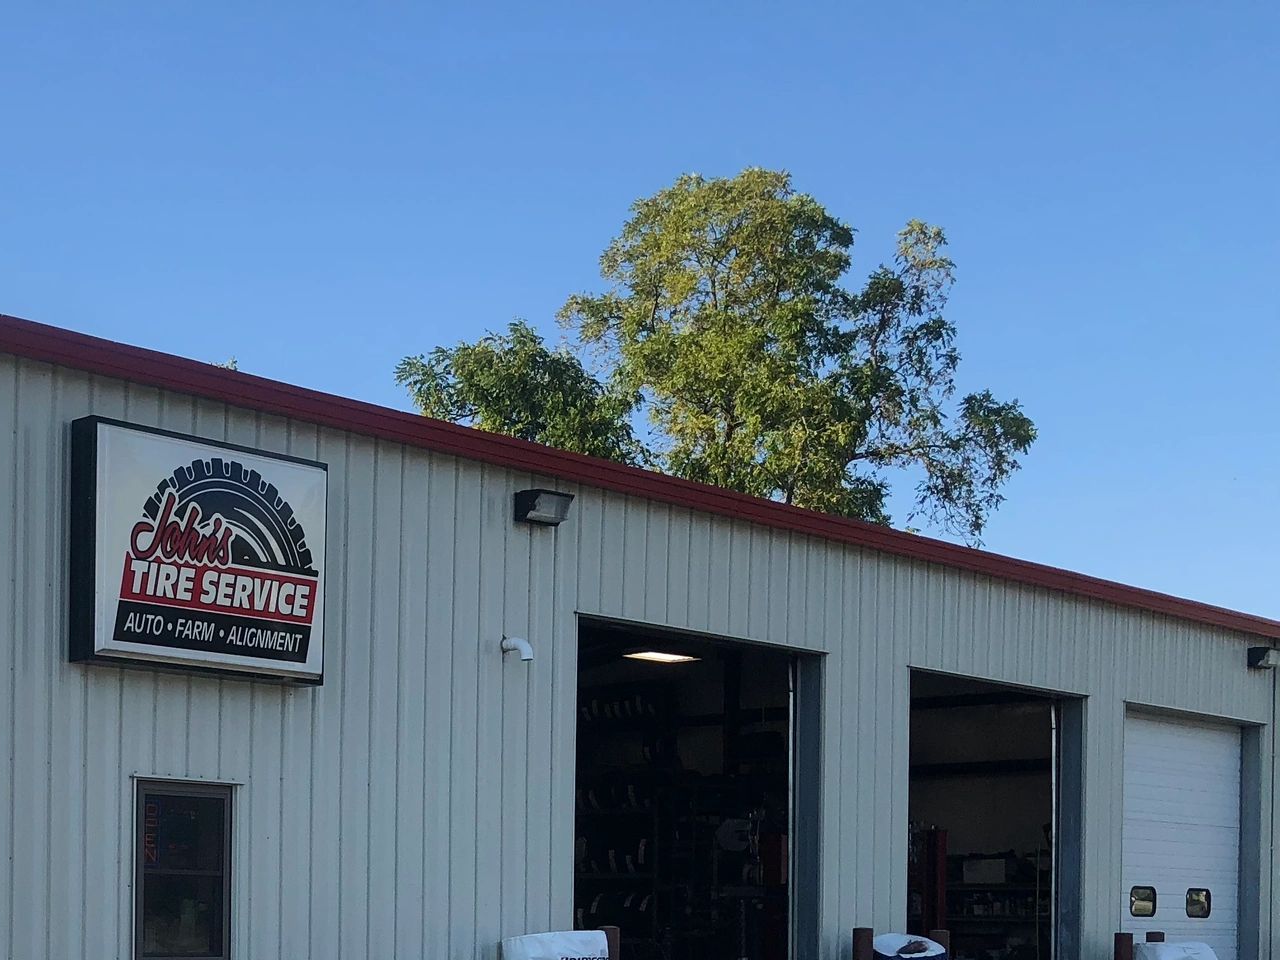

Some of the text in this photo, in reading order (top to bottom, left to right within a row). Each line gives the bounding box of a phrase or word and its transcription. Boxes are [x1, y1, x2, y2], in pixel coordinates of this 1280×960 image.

[130, 491, 233, 565] John's
[130, 560, 311, 617] TIRE SERVICE
[124, 612, 303, 653] AUTO FARM ALIGNMENT
